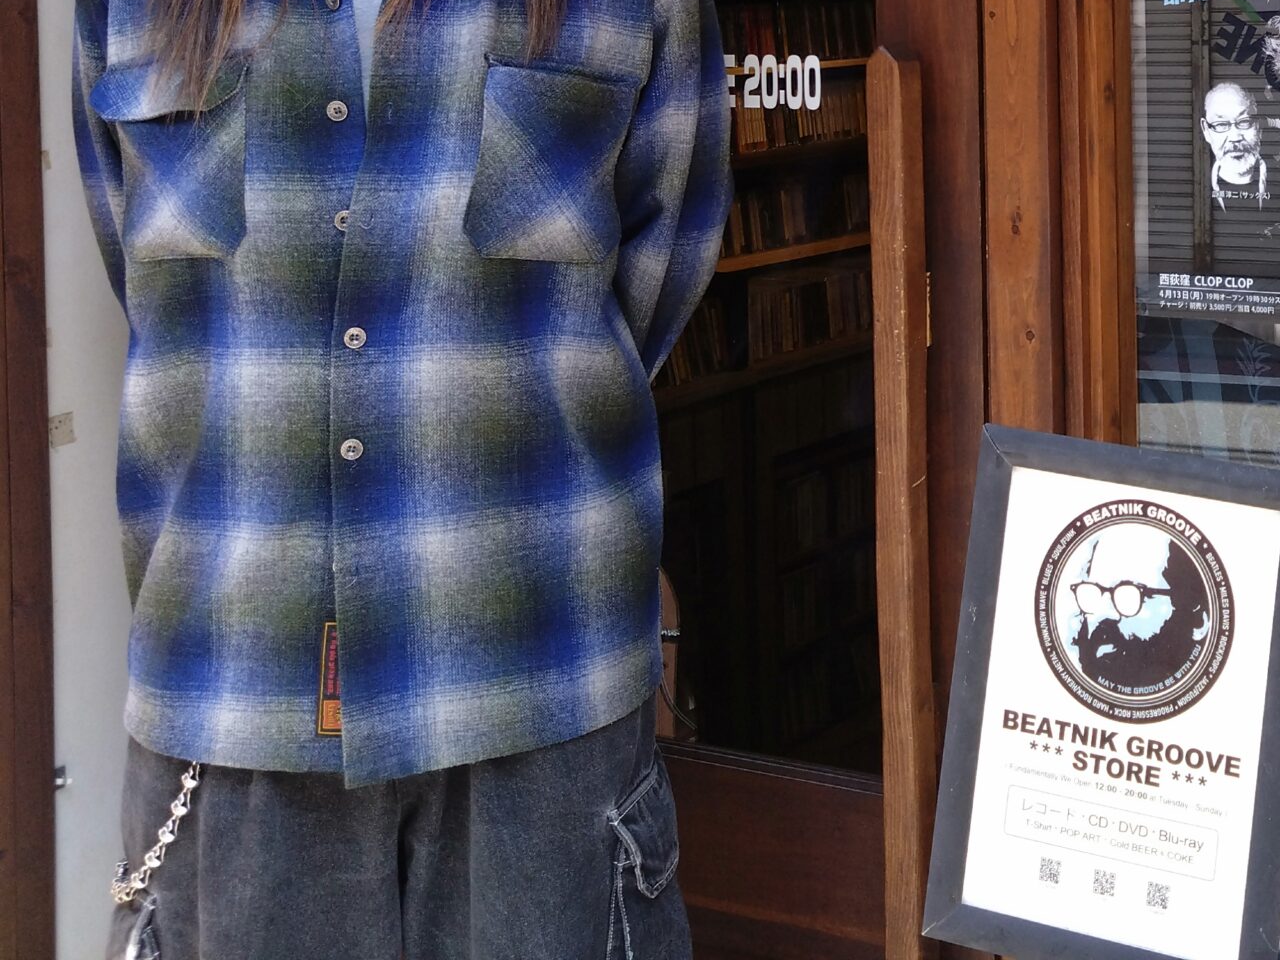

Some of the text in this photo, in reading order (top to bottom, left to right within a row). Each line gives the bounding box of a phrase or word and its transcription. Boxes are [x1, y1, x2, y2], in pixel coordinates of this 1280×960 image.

[744, 54, 821, 110] 20:00
[1194, 275, 1222, 287] CLOP
[1225, 277, 1253, 289] CLOP
[1083, 503, 1202, 545] BEATNIK GROOVE
[1042, 563, 1053, 585] BLUES
[1098, 644, 1201, 694] MAY THE GROOVE BE WITH YOU
[1002, 709, 1241, 778] BEATNIK GROOVE
[1072, 750, 1161, 787] STORE
[1060, 826, 1080, 837] POP
[1131, 843, 1158, 856] BEER
[1167, 851, 1194, 864] COKE
[1088, 814, 1108, 828] CD
[1119, 821, 1148, 837] DVD
[1159, 829, 1204, 852] Blu-ray
